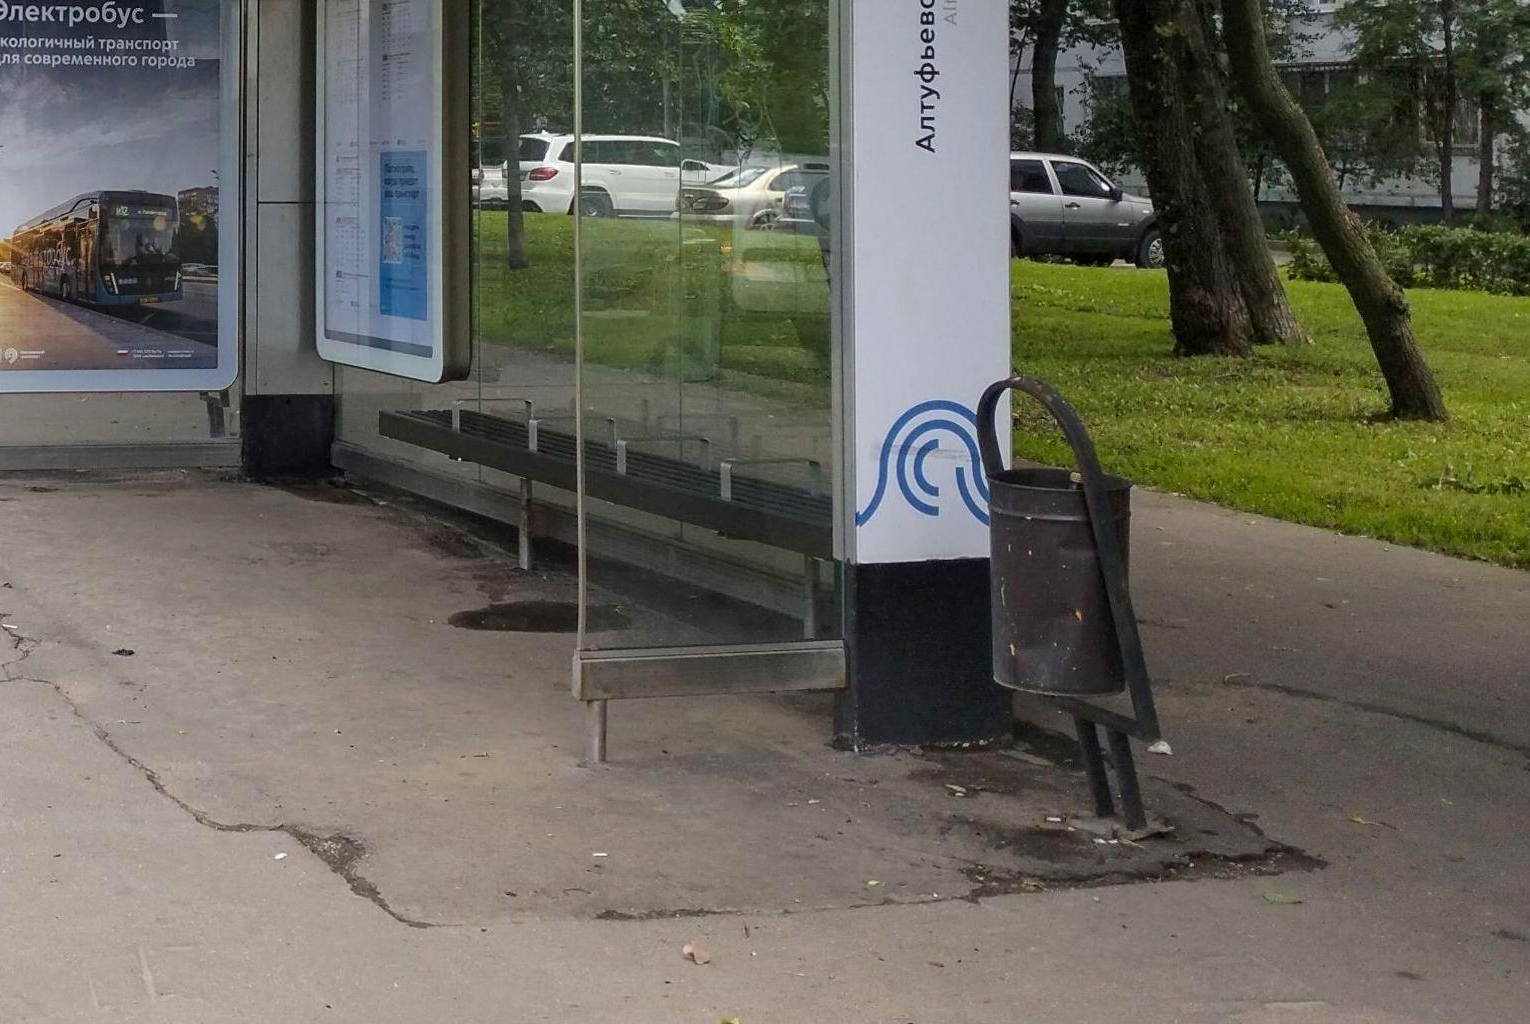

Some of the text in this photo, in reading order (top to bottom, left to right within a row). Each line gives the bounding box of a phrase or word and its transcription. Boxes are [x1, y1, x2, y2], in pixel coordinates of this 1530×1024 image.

[97, 38, 180, 51] транспорт
[23, 54, 139, 68] современного
[141, 56, 196, 69] города
